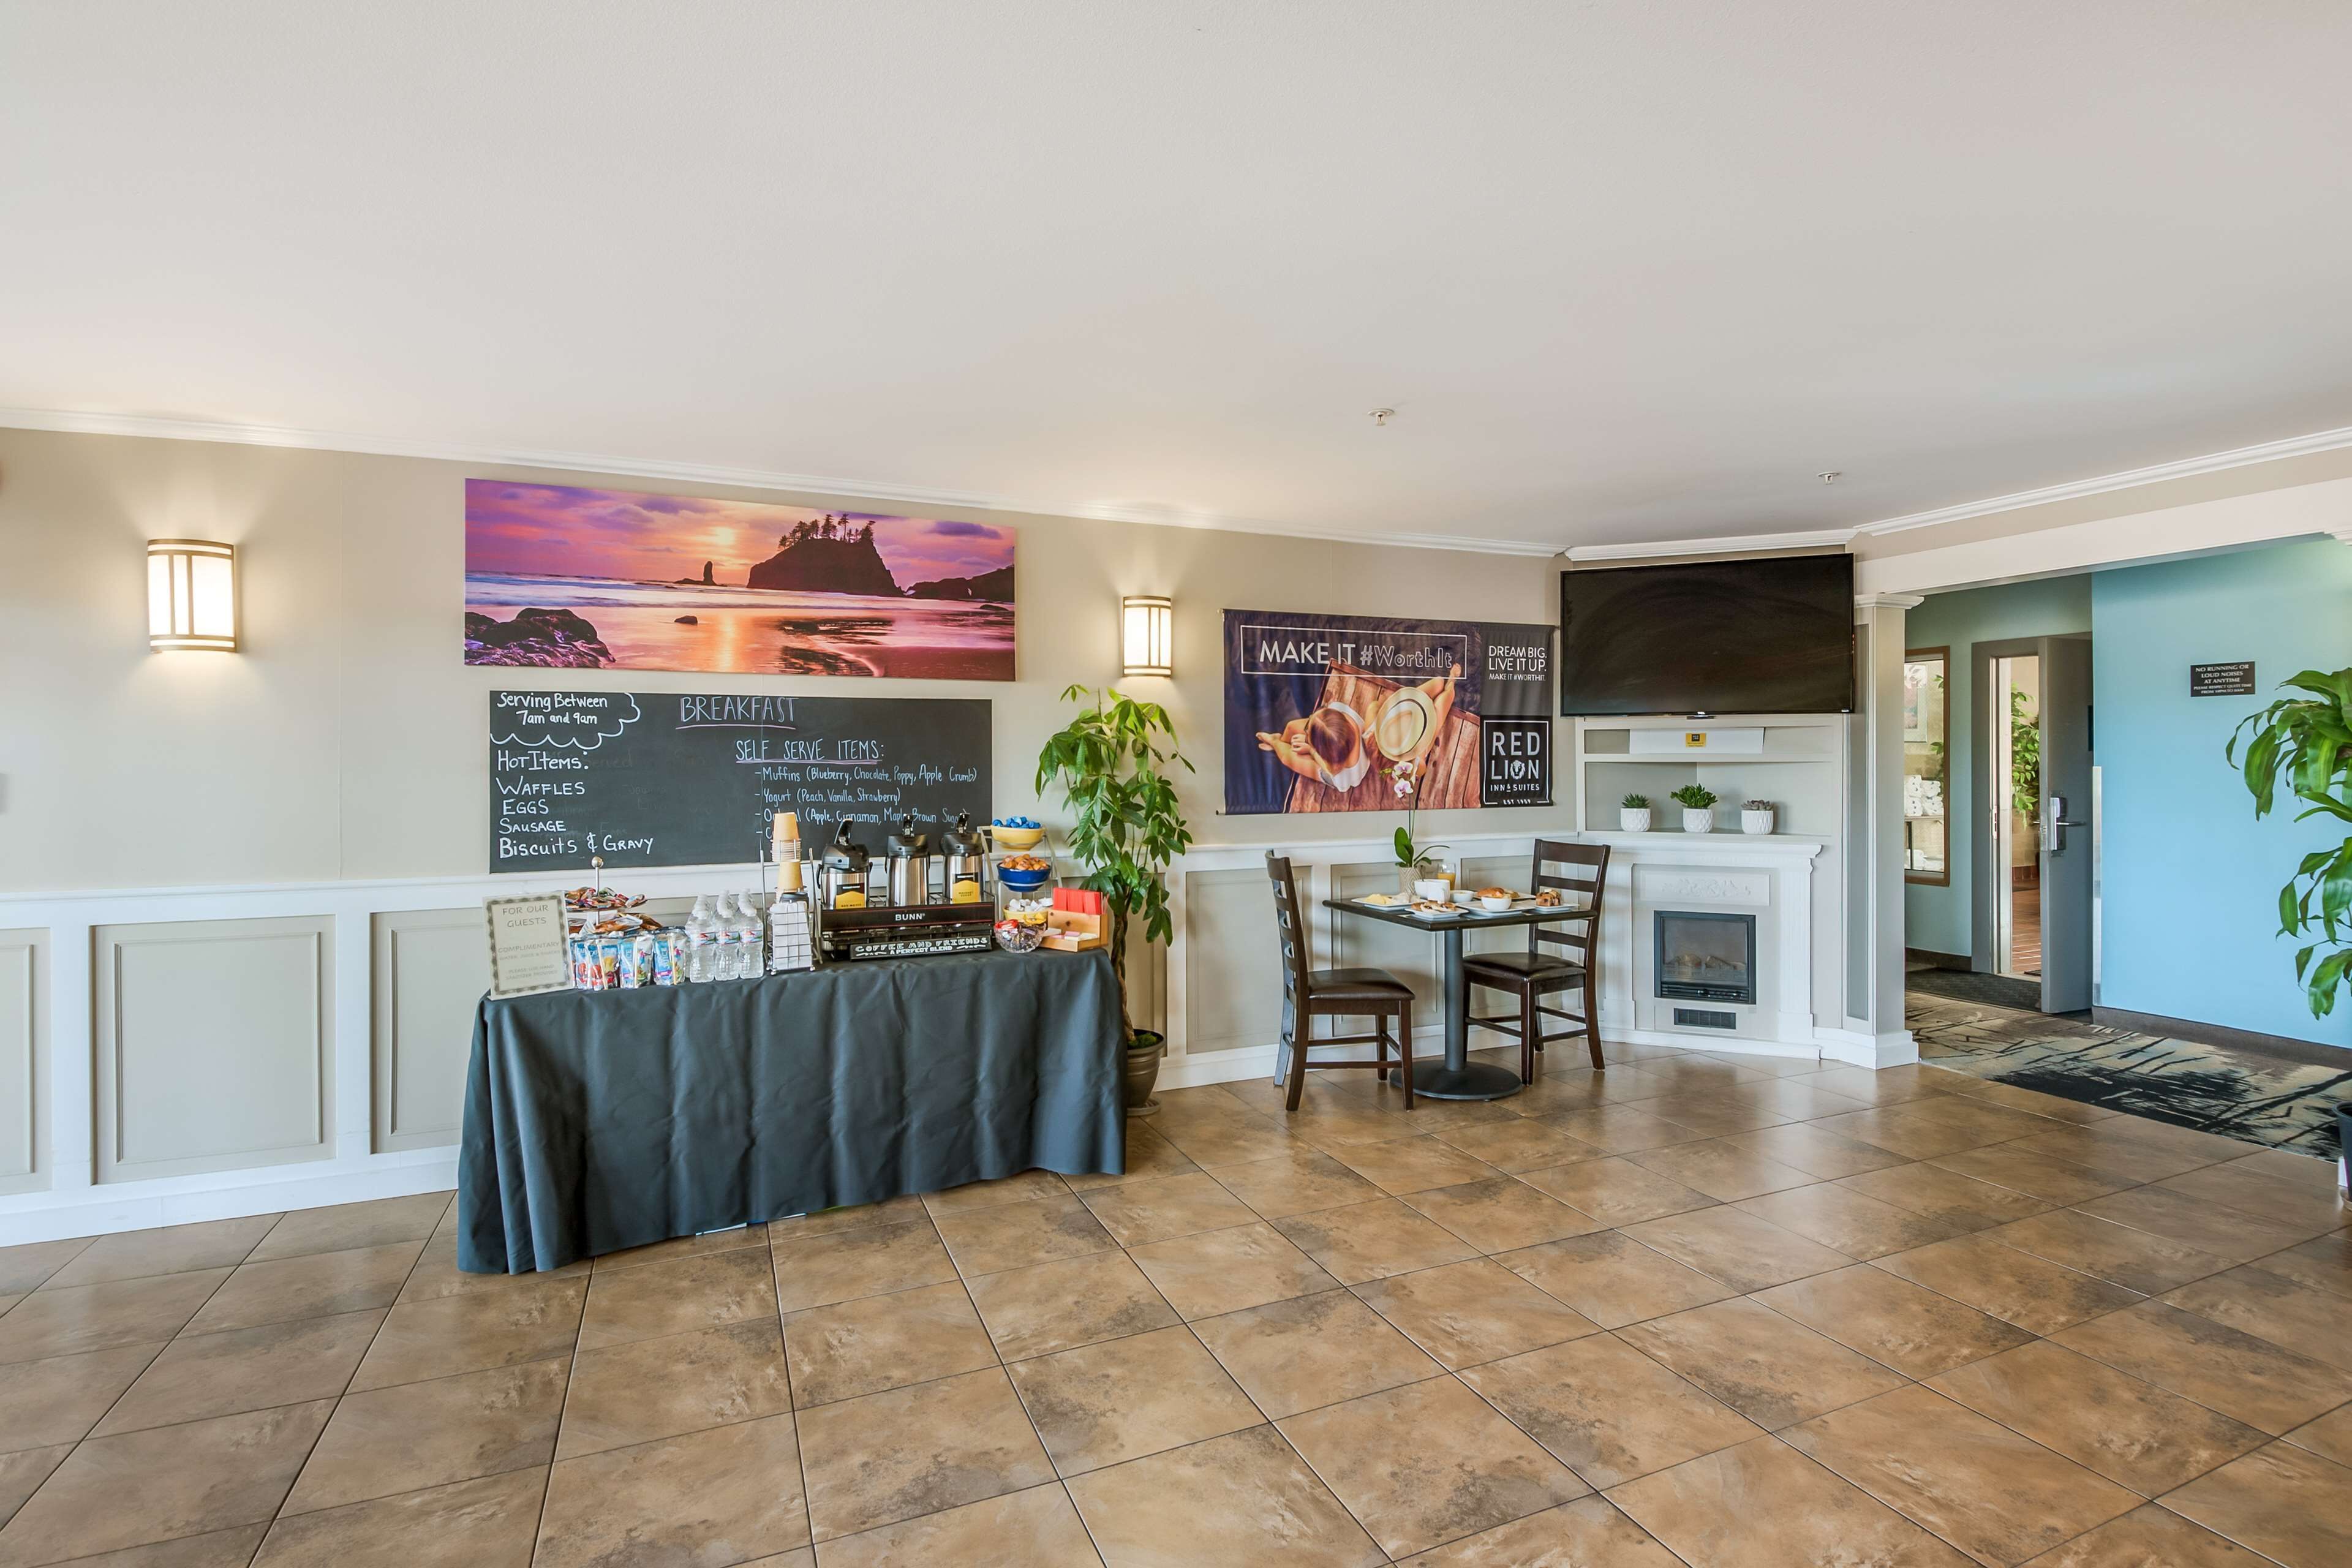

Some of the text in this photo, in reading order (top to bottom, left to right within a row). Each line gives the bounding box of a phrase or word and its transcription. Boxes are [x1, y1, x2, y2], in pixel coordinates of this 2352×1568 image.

[1259, 640, 1452, 668] MAKE IT #WorthIt
[1488, 645, 1547, 658] DREAM BIG.
[1488, 657, 1547, 672] LIVE IT UP.
[497, 692, 608, 712] Serving Between
[680, 696, 799, 723] BREAKFAST
[516, 710, 597, 725] 7am and 9am
[735, 738, 884, 761] SELF SERVE ITEMS:
[1491, 731, 1540, 756] RED
[806, 766, 852, 786] (Blueberry,
[854, 766, 892, 783] Chocolate,
[894, 765, 917, 786] Poppy,
[919, 764, 943, 786] Apple
[949, 766, 977, 783] Crumb)
[797, 788, 826, 804] (Peach,
[827, 788, 856, 804] Vanilla,
[858, 787, 900, 806] Strawberry)
[503, 798, 549, 815] EGGS
[805, 807, 834, 826] (Apple,
[836, 810, 882, 826] Cinnamon,
[912, 807, 937, 823] Brown
[499, 837, 578, 859] Biscuits
[586, 832, 598, 853] &
[502, 907, 523, 915] FOR
[507, 917, 547, 927] GUESTS
[498, 941, 560, 953] COMPLIMENTARY
[855, 943, 904, 952] COFFEE
[936, 937, 987, 946] FRIENDS
